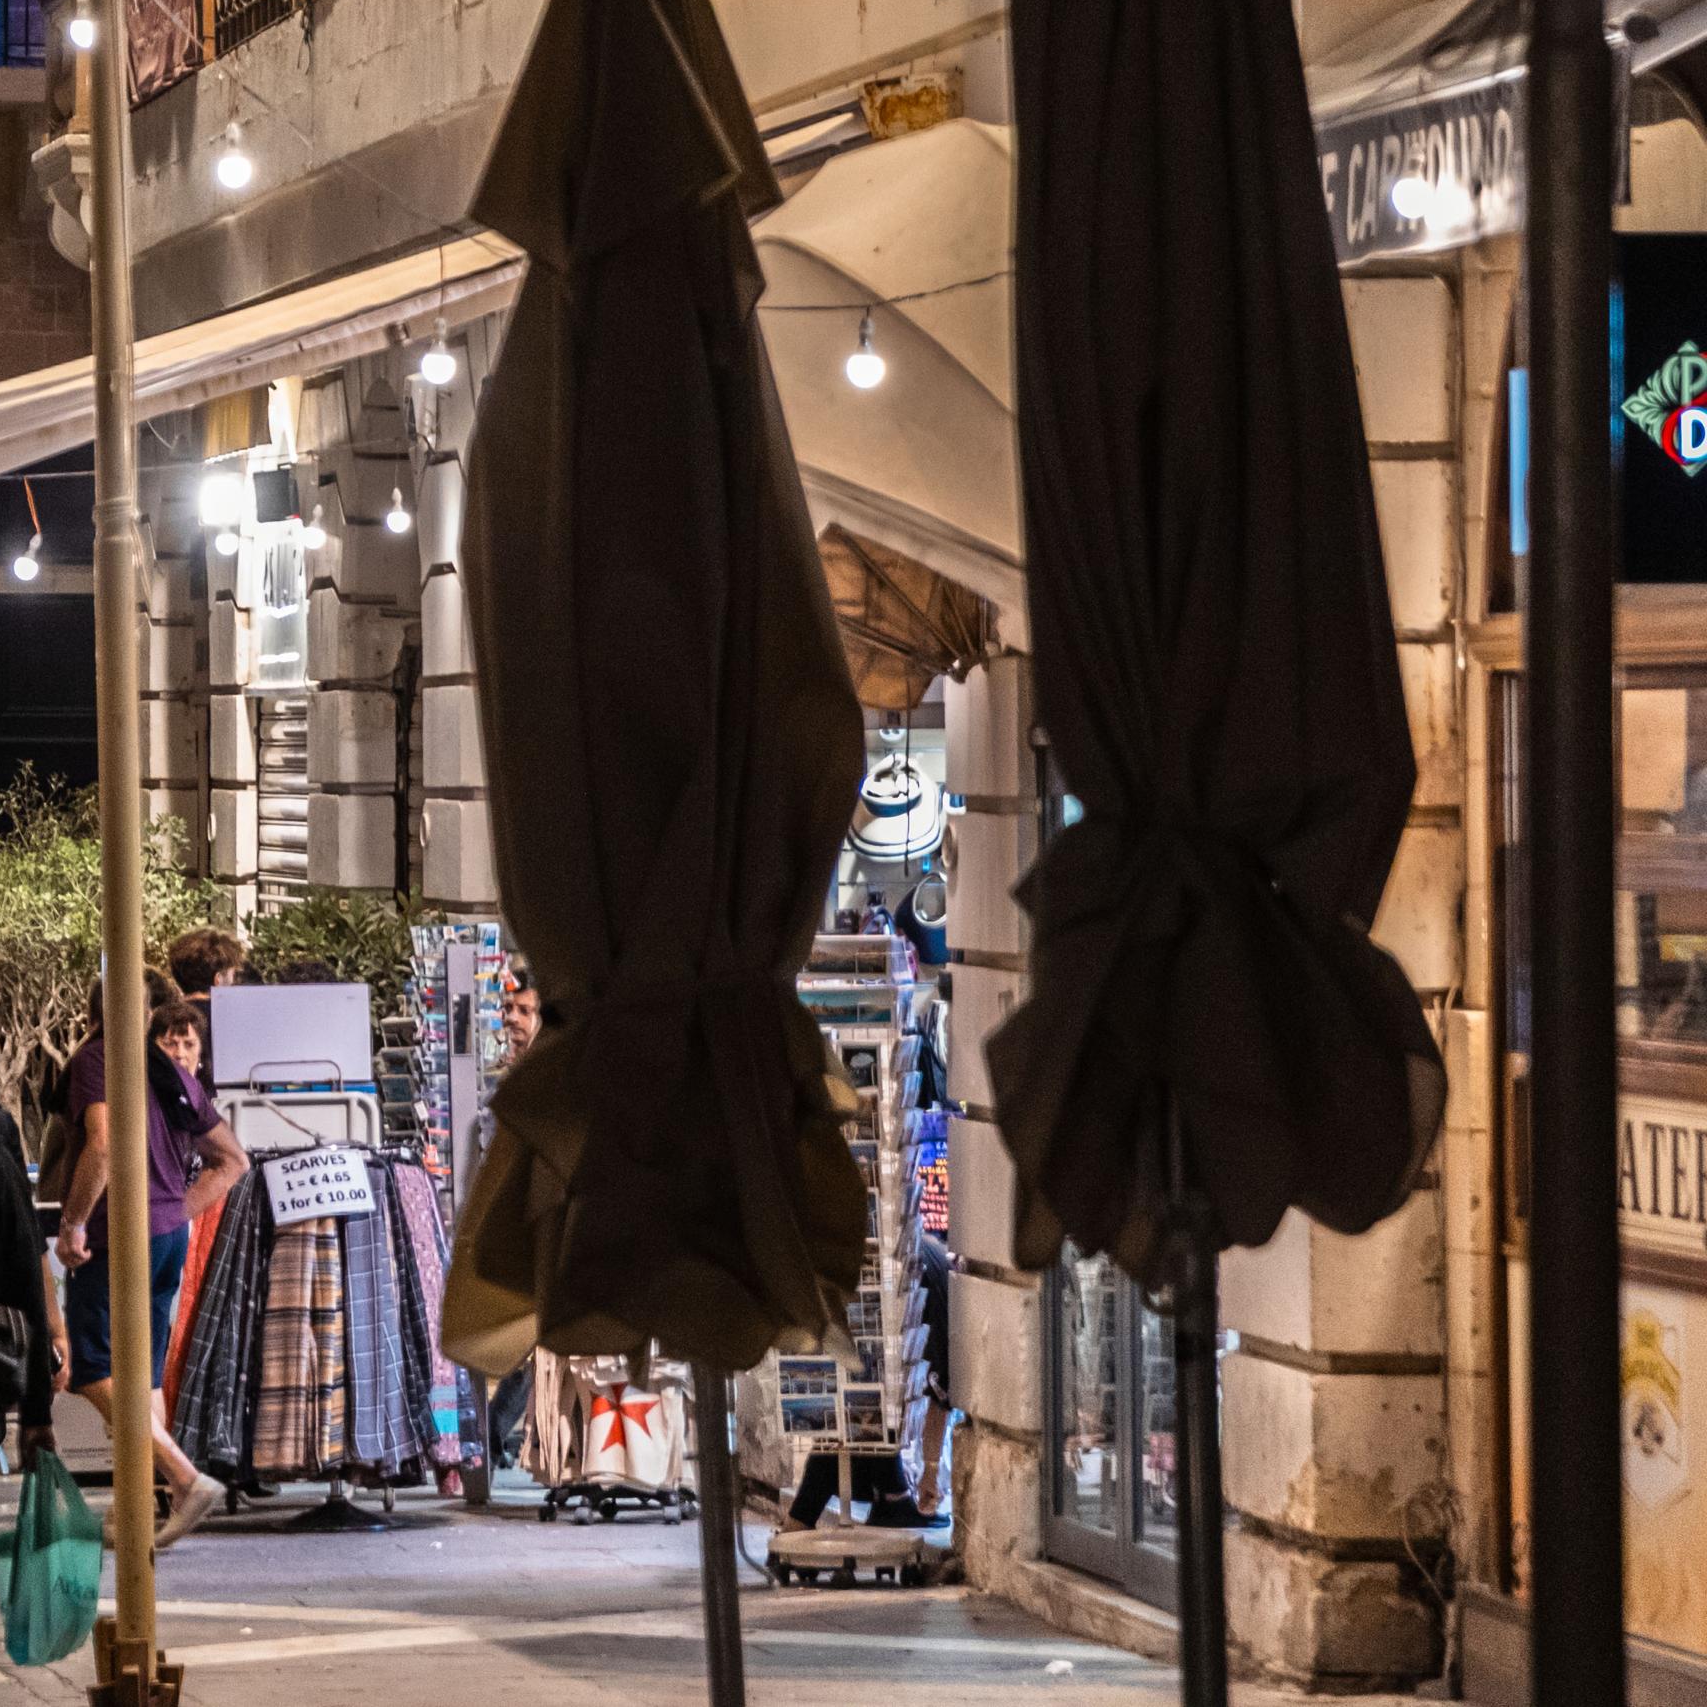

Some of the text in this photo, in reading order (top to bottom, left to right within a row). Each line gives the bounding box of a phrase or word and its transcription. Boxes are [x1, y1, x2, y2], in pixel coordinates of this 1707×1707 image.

[280, 1154, 347, 1174] SCARVES
[285, 1179, 293, 1191] 1
[309, 1174, 319, 1187] €
[321, 1171, 351, 1184] 4.65
[277, 1187, 367, 1213] 3 for € 10.00
